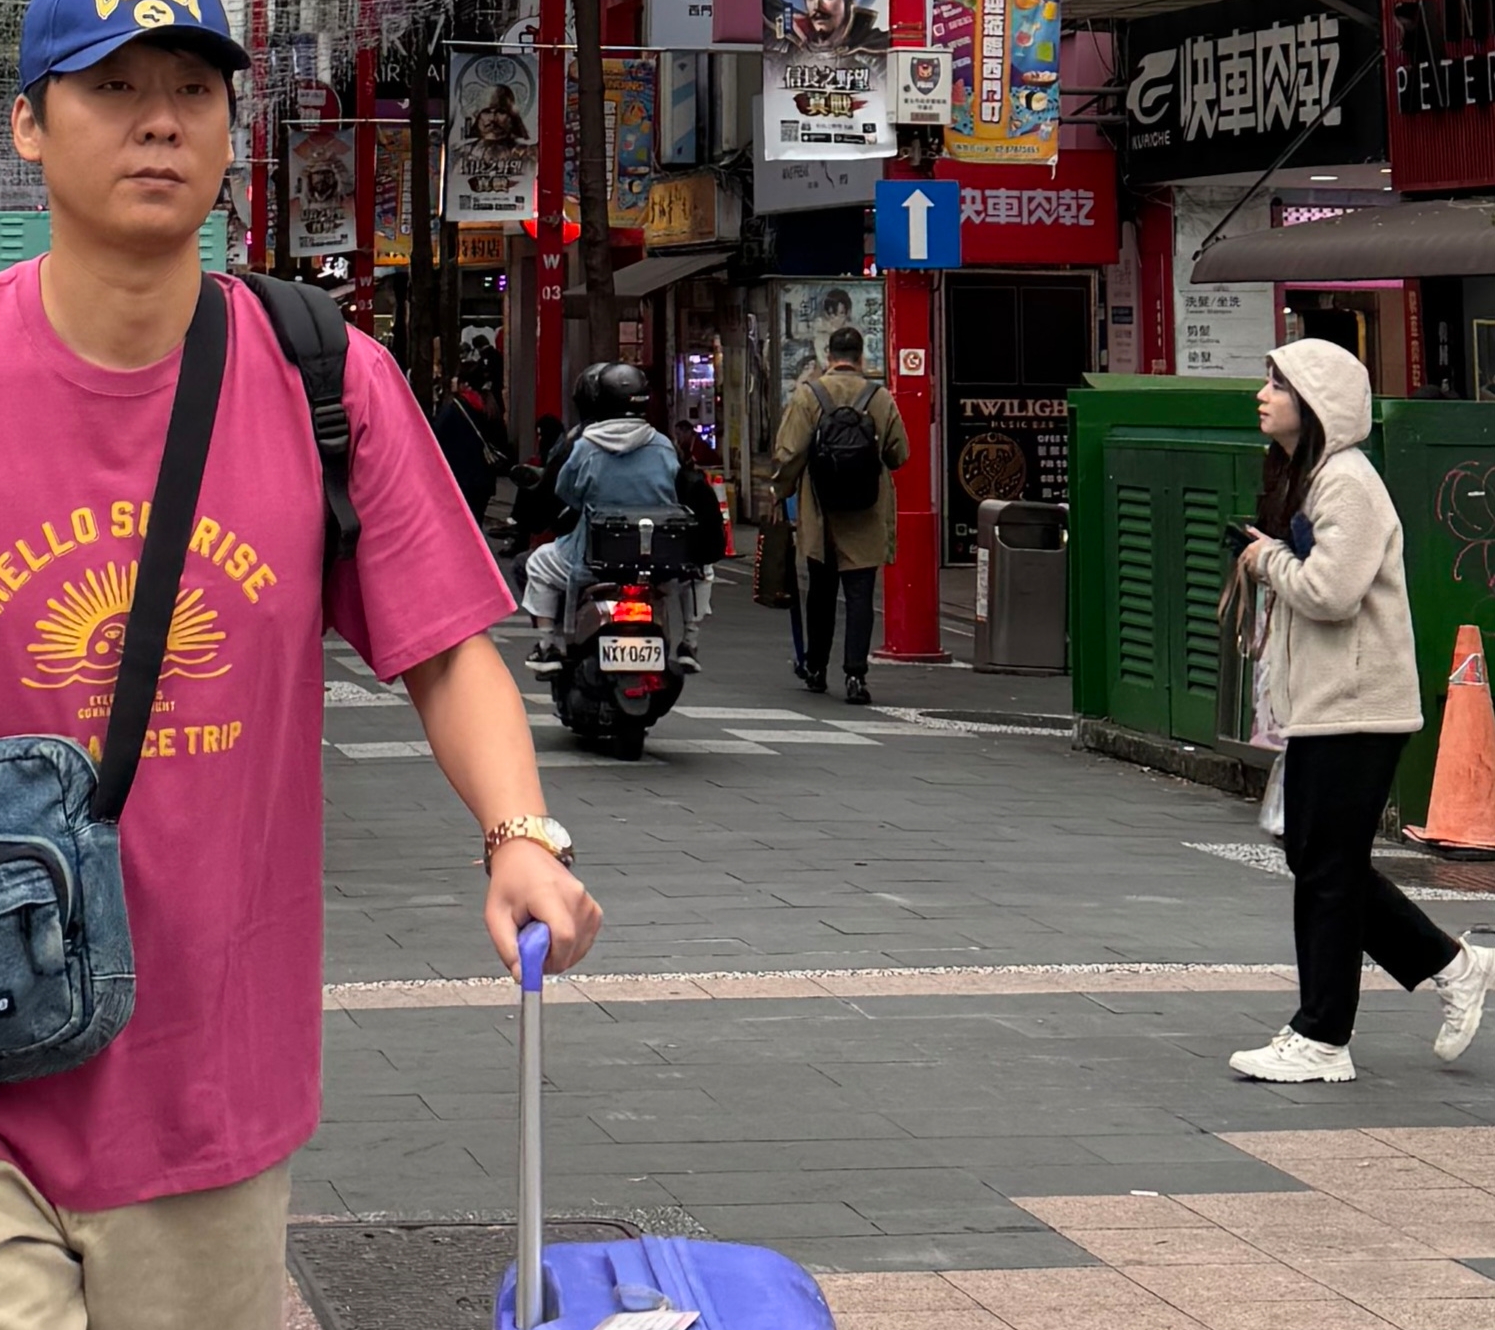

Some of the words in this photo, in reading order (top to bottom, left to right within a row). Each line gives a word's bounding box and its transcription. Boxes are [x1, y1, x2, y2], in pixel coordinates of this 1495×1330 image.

[1180, 11, 1343, 142] 快車肉乾
[542, 254, 561, 270] W
[542, 285, 562, 301] 03
[110, 500, 278, 604] SRISE
[184, 721, 242, 755] TRIP
